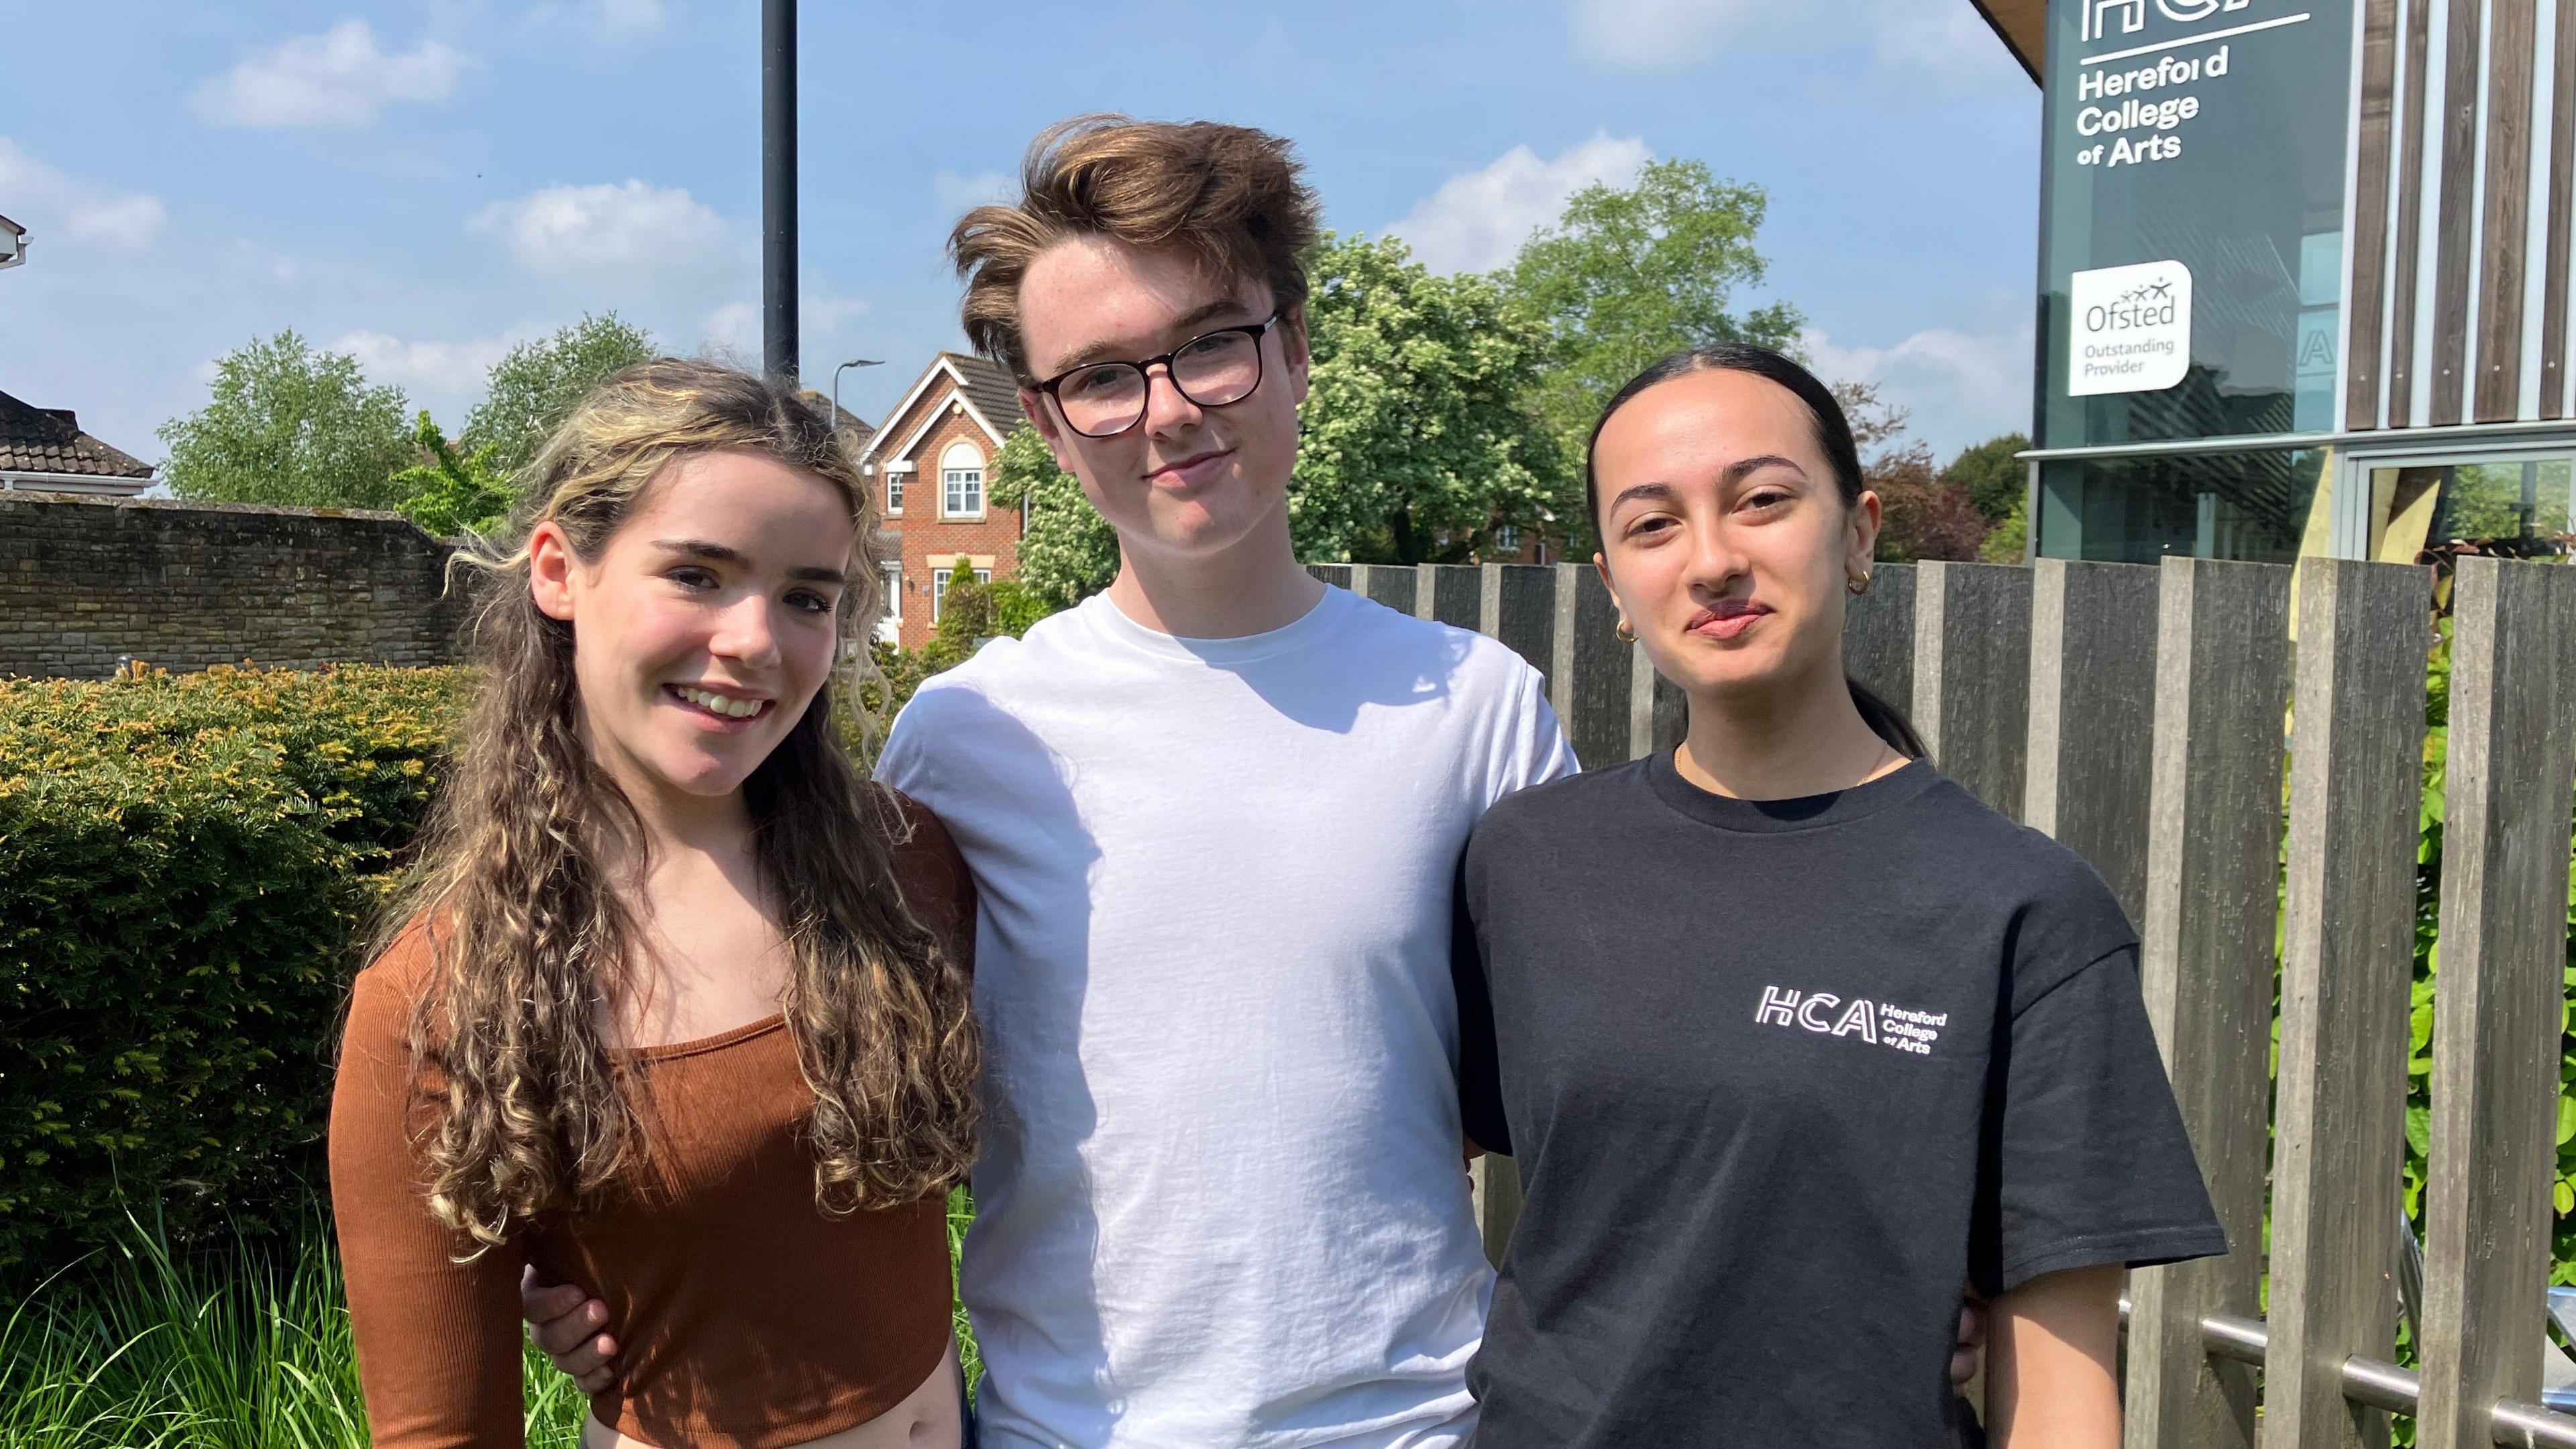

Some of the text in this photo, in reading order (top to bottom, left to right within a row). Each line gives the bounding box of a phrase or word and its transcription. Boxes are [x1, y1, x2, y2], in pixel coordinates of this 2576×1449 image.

[2076, 96, 2200, 136] College
[2076, 135, 2182, 168] of Arts
[2086, 294, 2175, 332] Ofsted
[2084, 338, 2174, 358] Outstanding
[2084, 360, 2145, 377] Provider
[1755, 985, 1878, 1044] HCA
[1880, 1002, 1948, 1027] Hereford
[1882, 1019, 1938, 1042] College
[1882, 1036, 1931, 1055] of Arts
